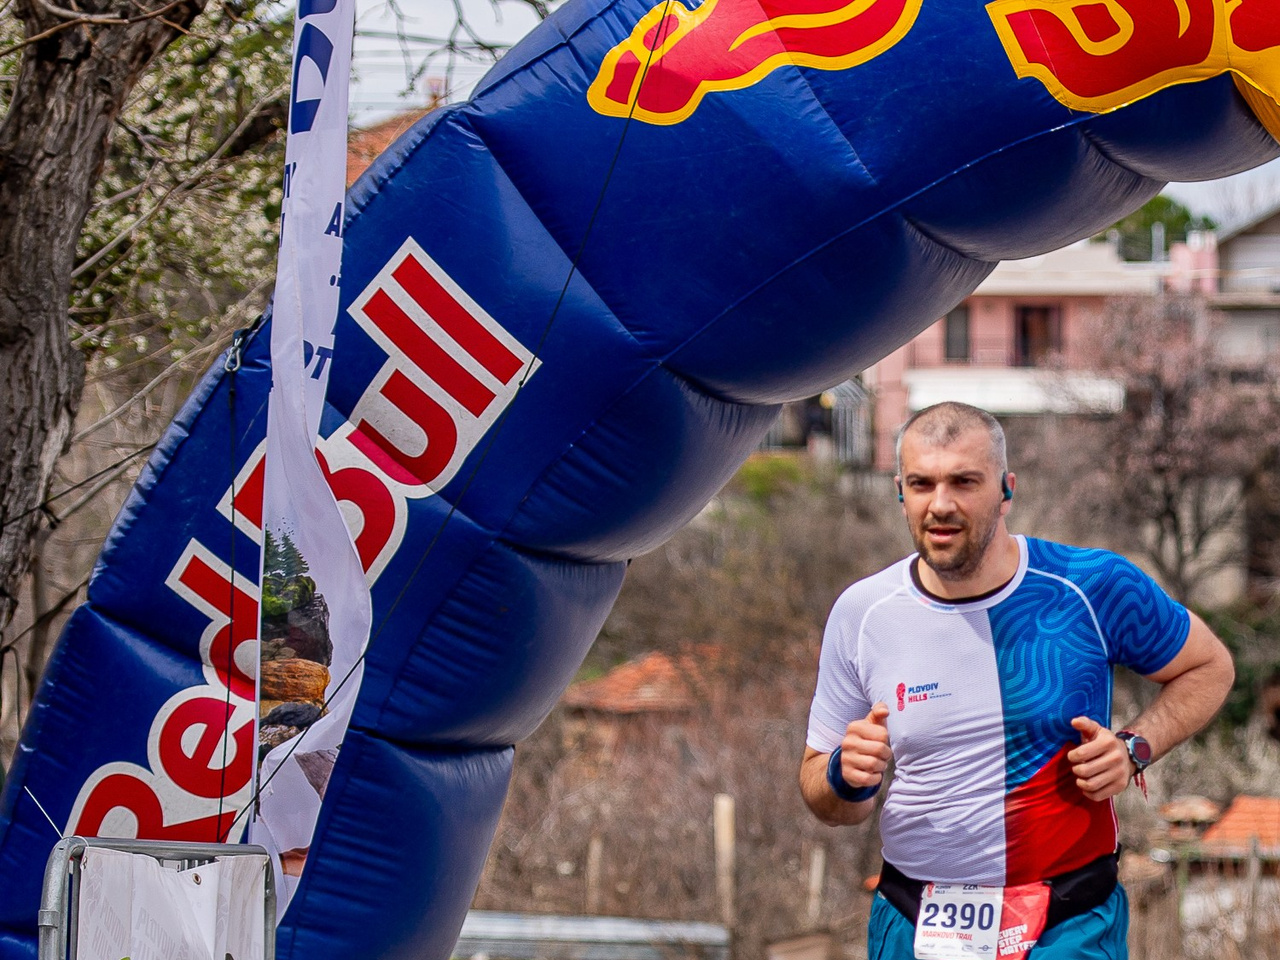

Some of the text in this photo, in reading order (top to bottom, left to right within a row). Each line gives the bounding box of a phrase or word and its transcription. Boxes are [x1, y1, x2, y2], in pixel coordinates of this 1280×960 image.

[908, 682, 939, 693] PLOVDIV
[908, 693, 928, 702] HILLS
[922, 903, 994, 930] 2390
[922, 930, 973, 941] MARKOVO TRAIL
